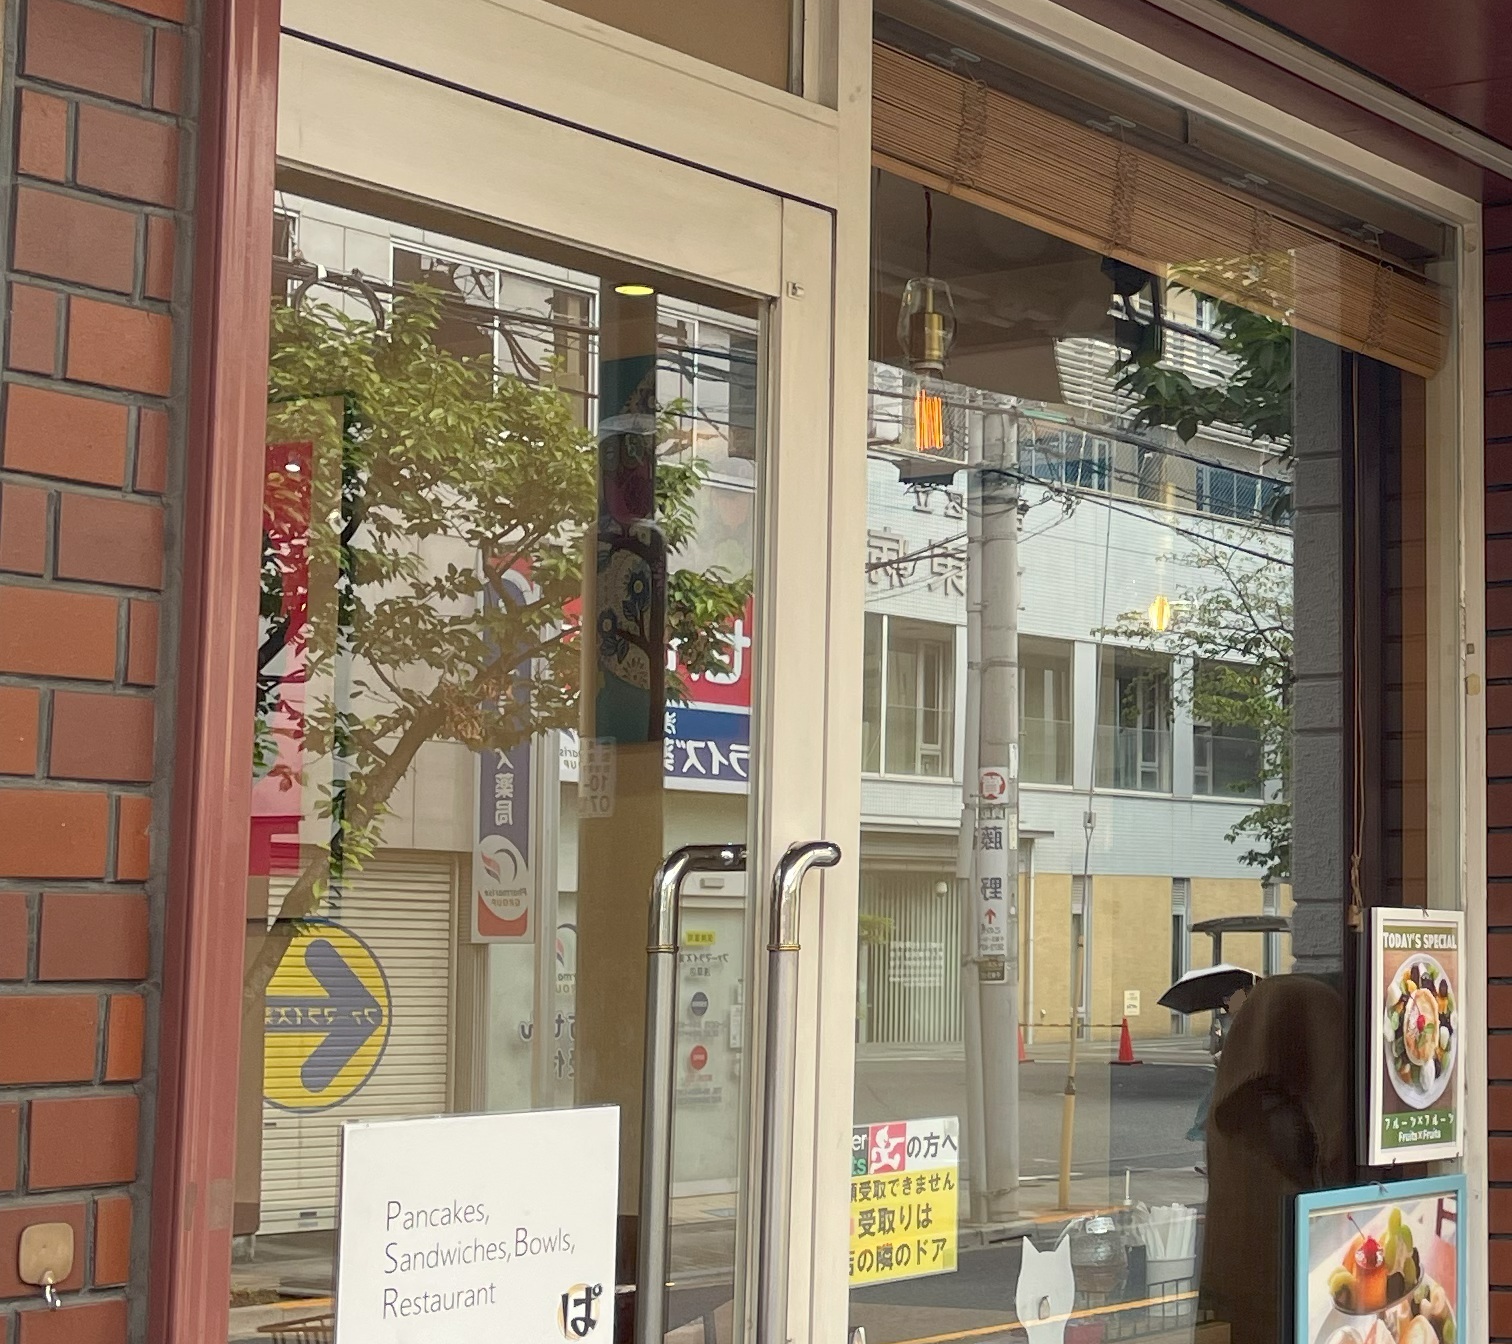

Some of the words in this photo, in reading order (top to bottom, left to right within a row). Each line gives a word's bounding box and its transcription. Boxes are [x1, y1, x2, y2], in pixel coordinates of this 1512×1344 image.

[1383, 931, 1422, 949] TODAY'S
[1423, 932, 1457, 950] SPECIAL
[906, 1131, 958, 1159] の方へ
[385, 1199, 490, 1232] Pancakes,
[858, 1202, 933, 1239] 受取りは
[382, 1282, 497, 1320] Restaurant
[560, 1283, 603, 1339] ぱ
